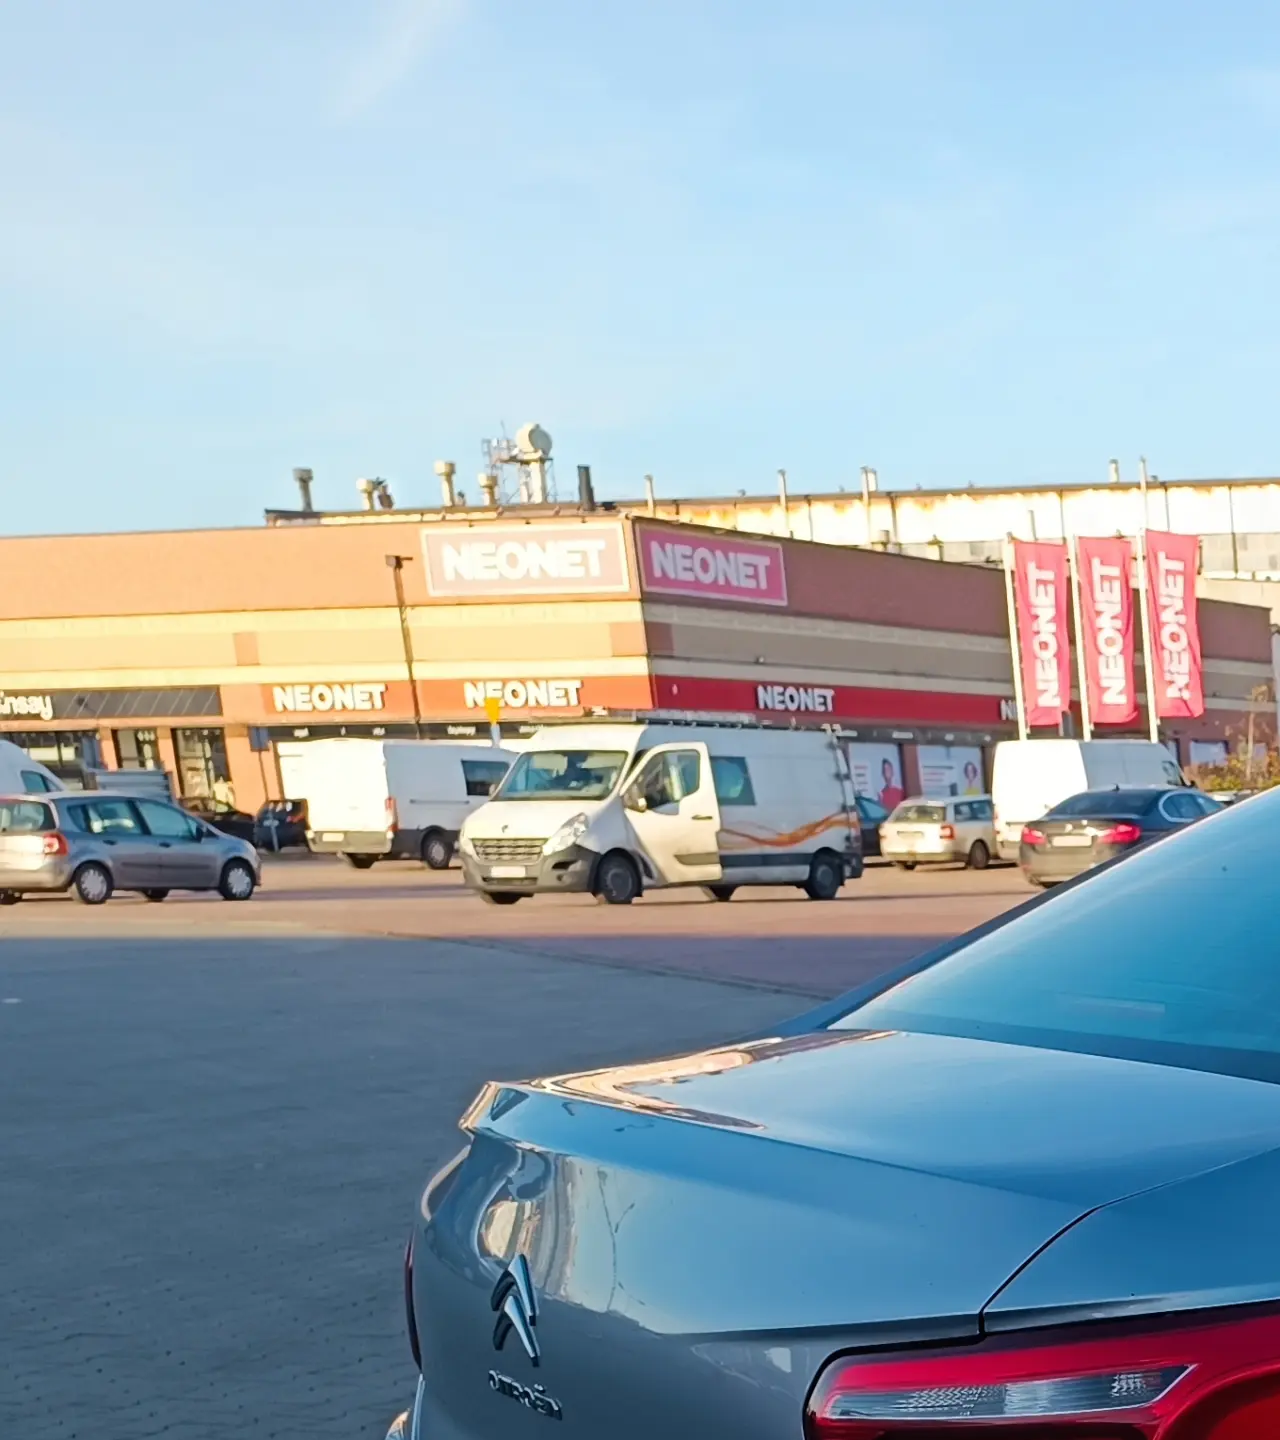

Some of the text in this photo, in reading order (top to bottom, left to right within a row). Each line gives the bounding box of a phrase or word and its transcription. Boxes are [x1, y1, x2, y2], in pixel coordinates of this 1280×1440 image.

[441, 539, 606, 581] NEONET
[649, 540, 771, 590] NEONET
[1027, 560, 1061, 707] NEONET
[1091, 556, 1127, 705] NEONET
[1157, 551, 1191, 700] NEONET
[272, 682, 388, 711] NEONET
[464, 679, 583, 708] NEONET
[757, 685, 834, 713] NEONET
